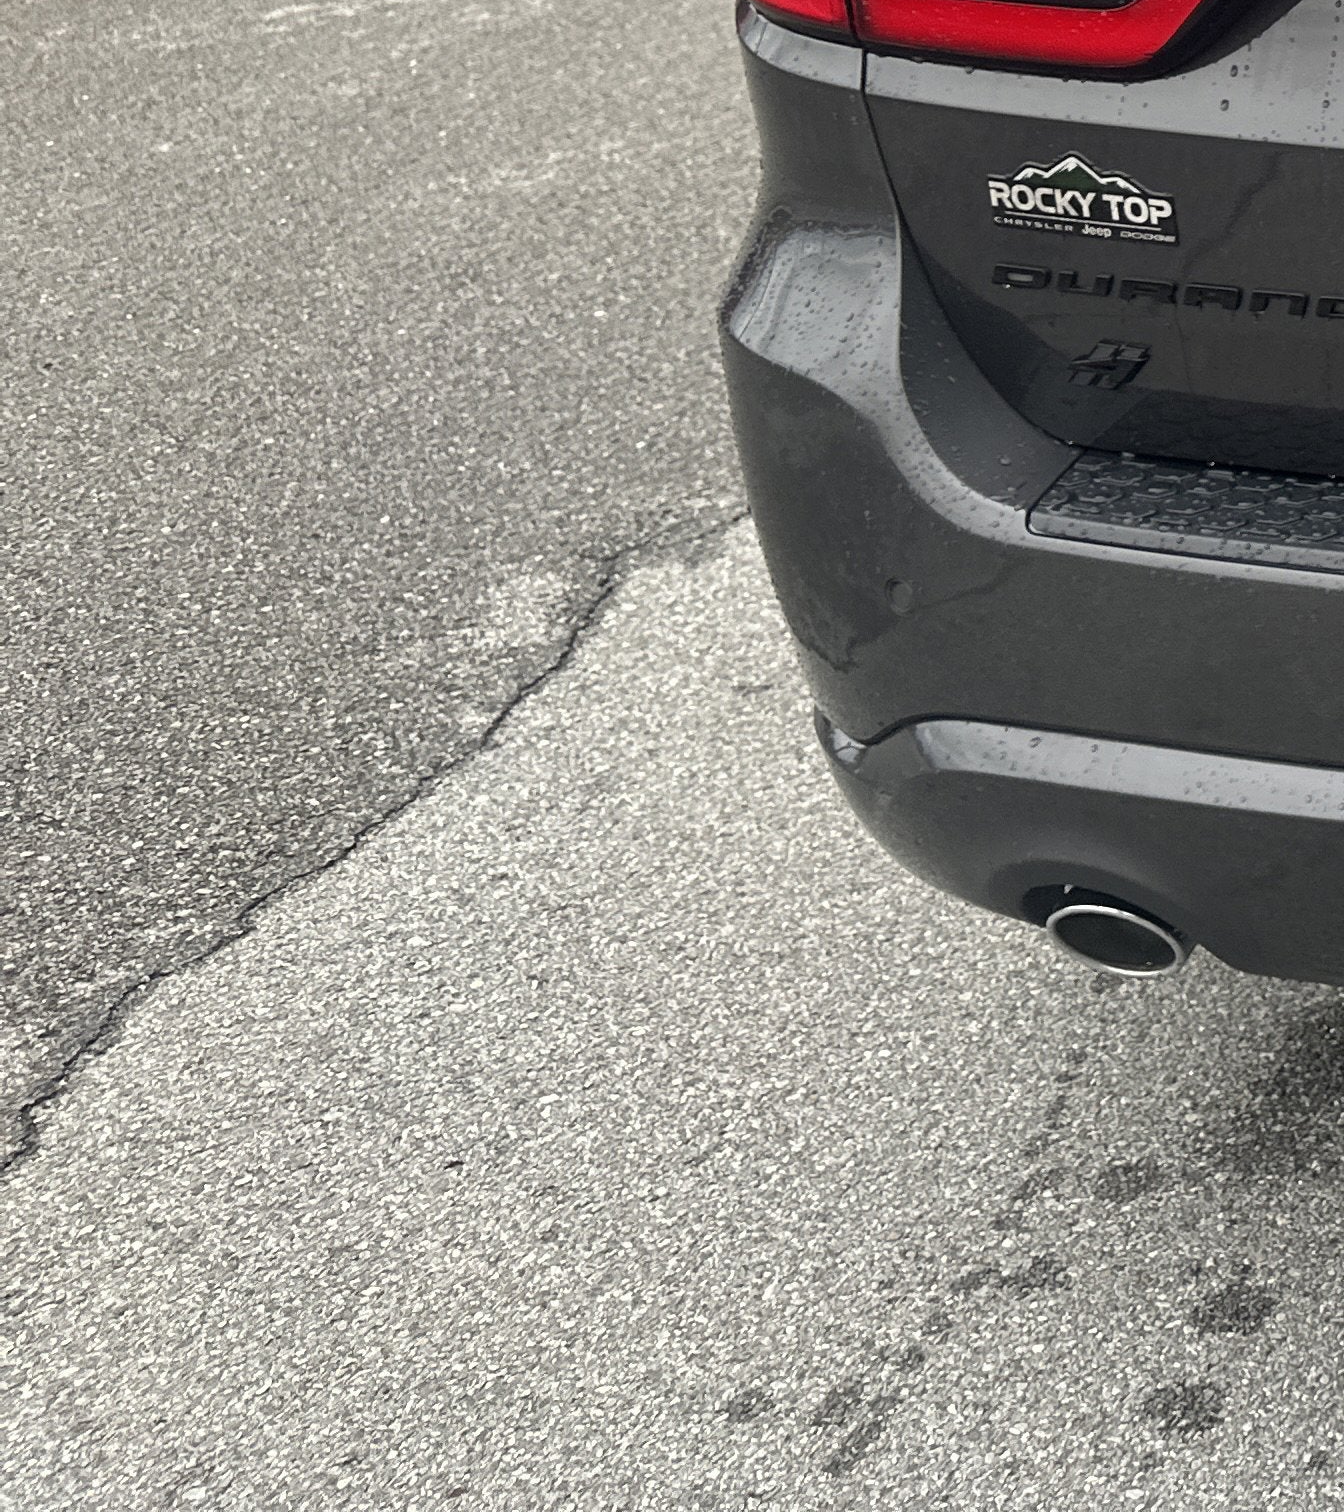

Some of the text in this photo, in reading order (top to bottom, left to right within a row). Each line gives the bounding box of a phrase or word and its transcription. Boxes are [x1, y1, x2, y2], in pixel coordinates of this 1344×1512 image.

[987, 180, 1173, 226] ROCKY TOP
[993, 216, 1177, 243] CHRYSLER Jeep DODGE
